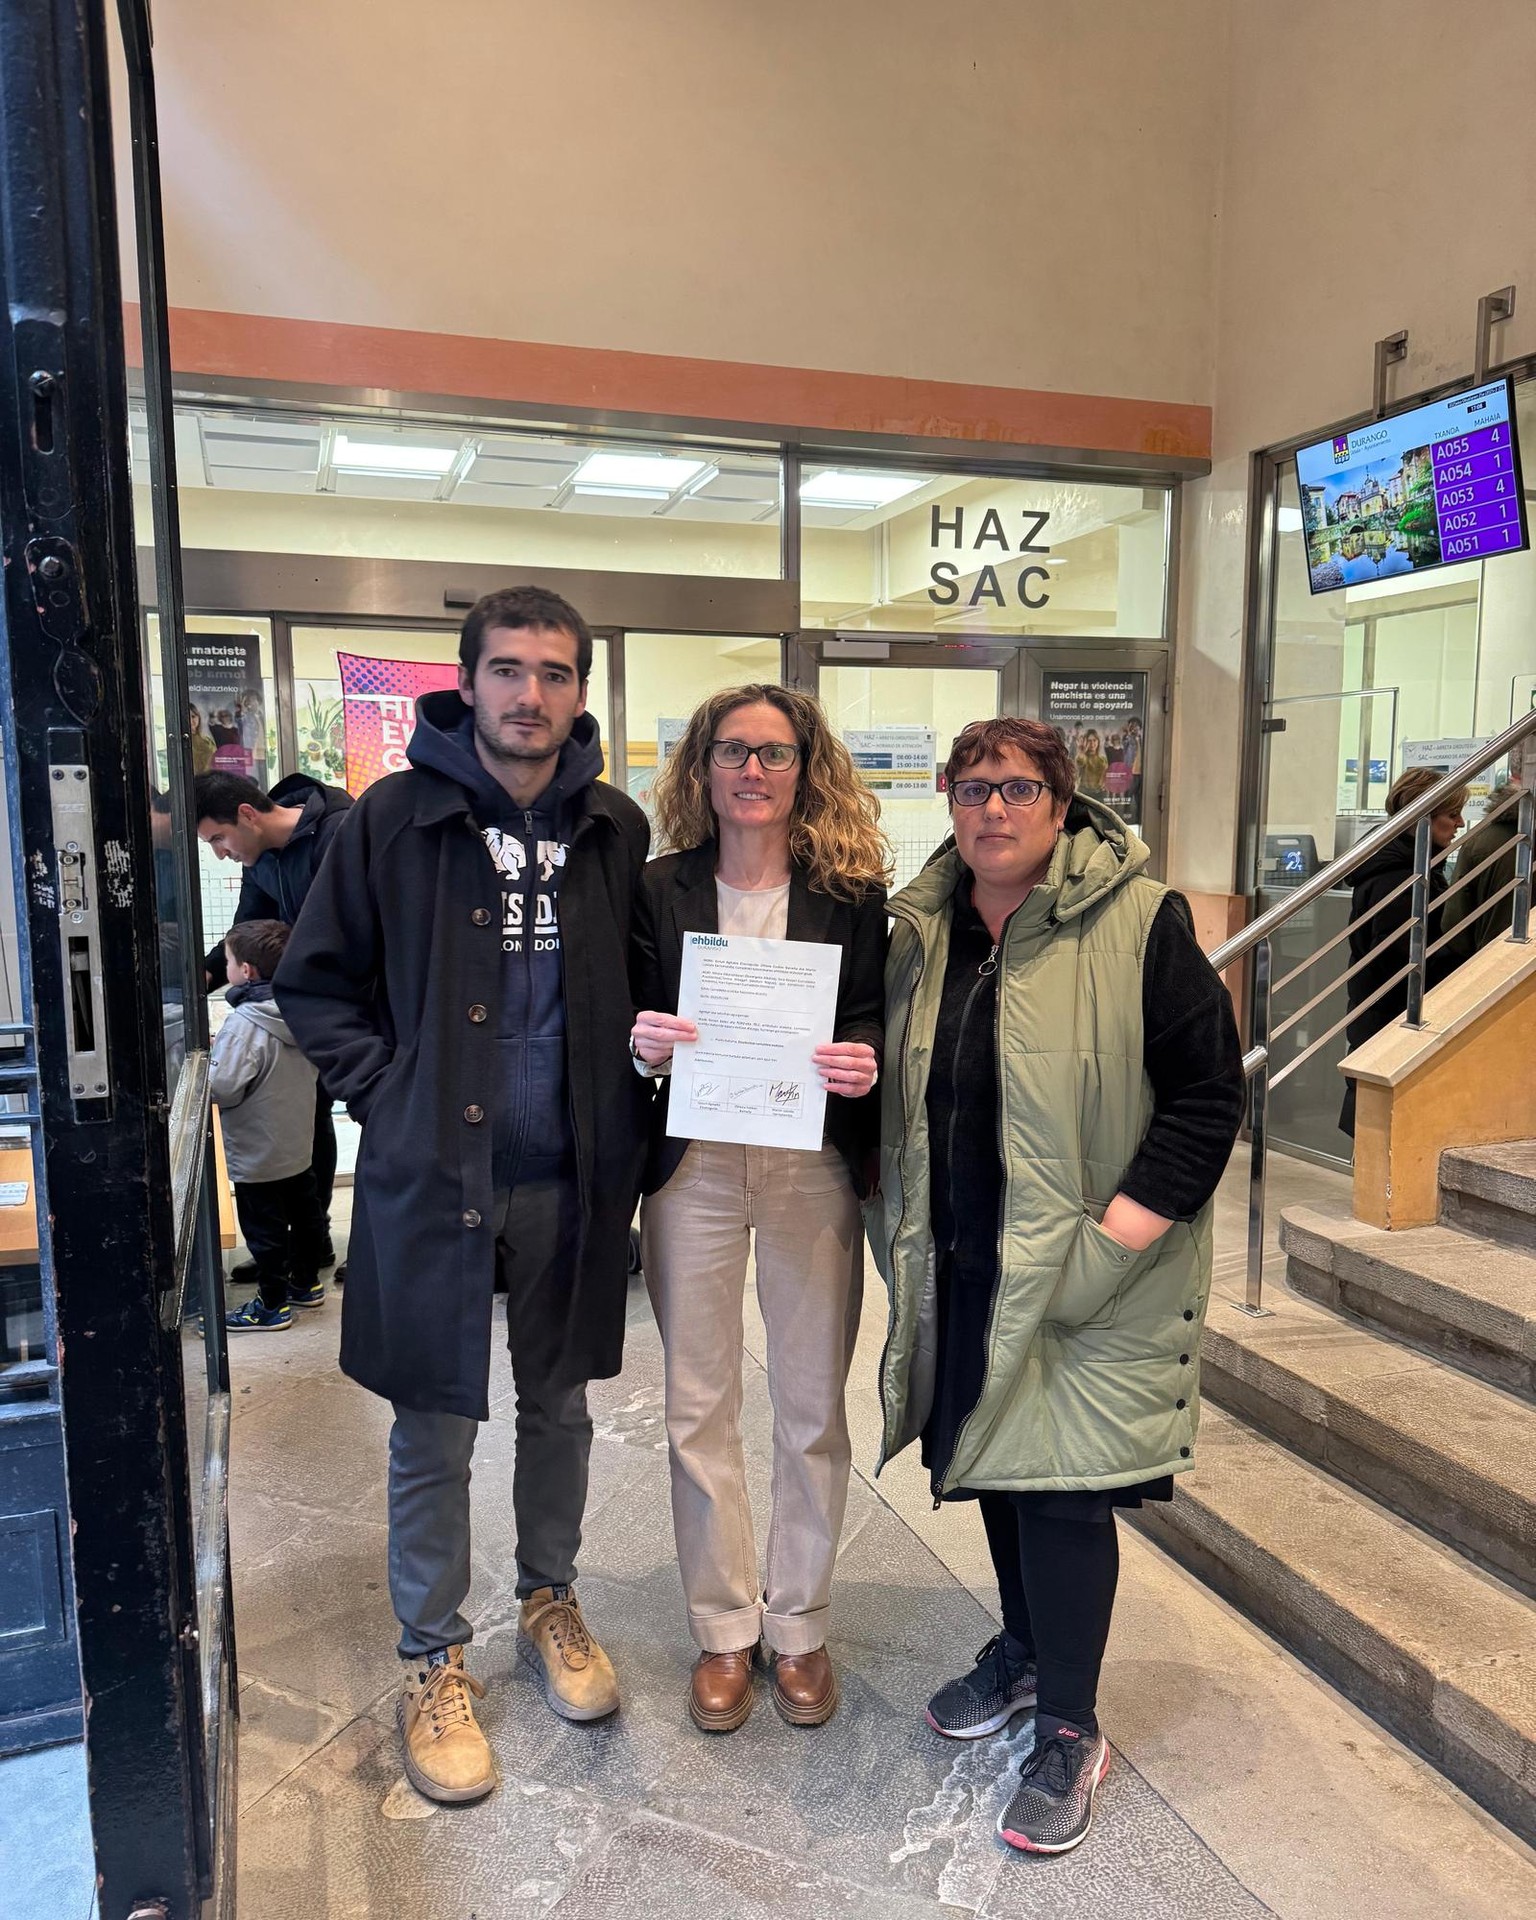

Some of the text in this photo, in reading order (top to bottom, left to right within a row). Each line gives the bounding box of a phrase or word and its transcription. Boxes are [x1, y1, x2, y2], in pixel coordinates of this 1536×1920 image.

[1434, 413, 1501, 439] TXANDA MAHAIA
[1351, 430, 1388, 449] DURANGO
[1437, 428, 1500, 461] A055 4
[1439, 453, 1501, 484] A054 1
[1441, 479, 1505, 509] A053 4
[930, 505, 1050, 553] HAZ
[1444, 504, 1507, 532] A052 1
[1446, 529, 1510, 556] A051 1
[928, 562, 1050, 608] SAC
[191, 646, 246, 656] matxista
[1050, 691, 1092, 700] machista
[1051, 681, 1133, 691] Negar la violencia
[1050, 701, 1133, 711] forma de apoyarla
[692, 935, 729, 948] ehbildu
